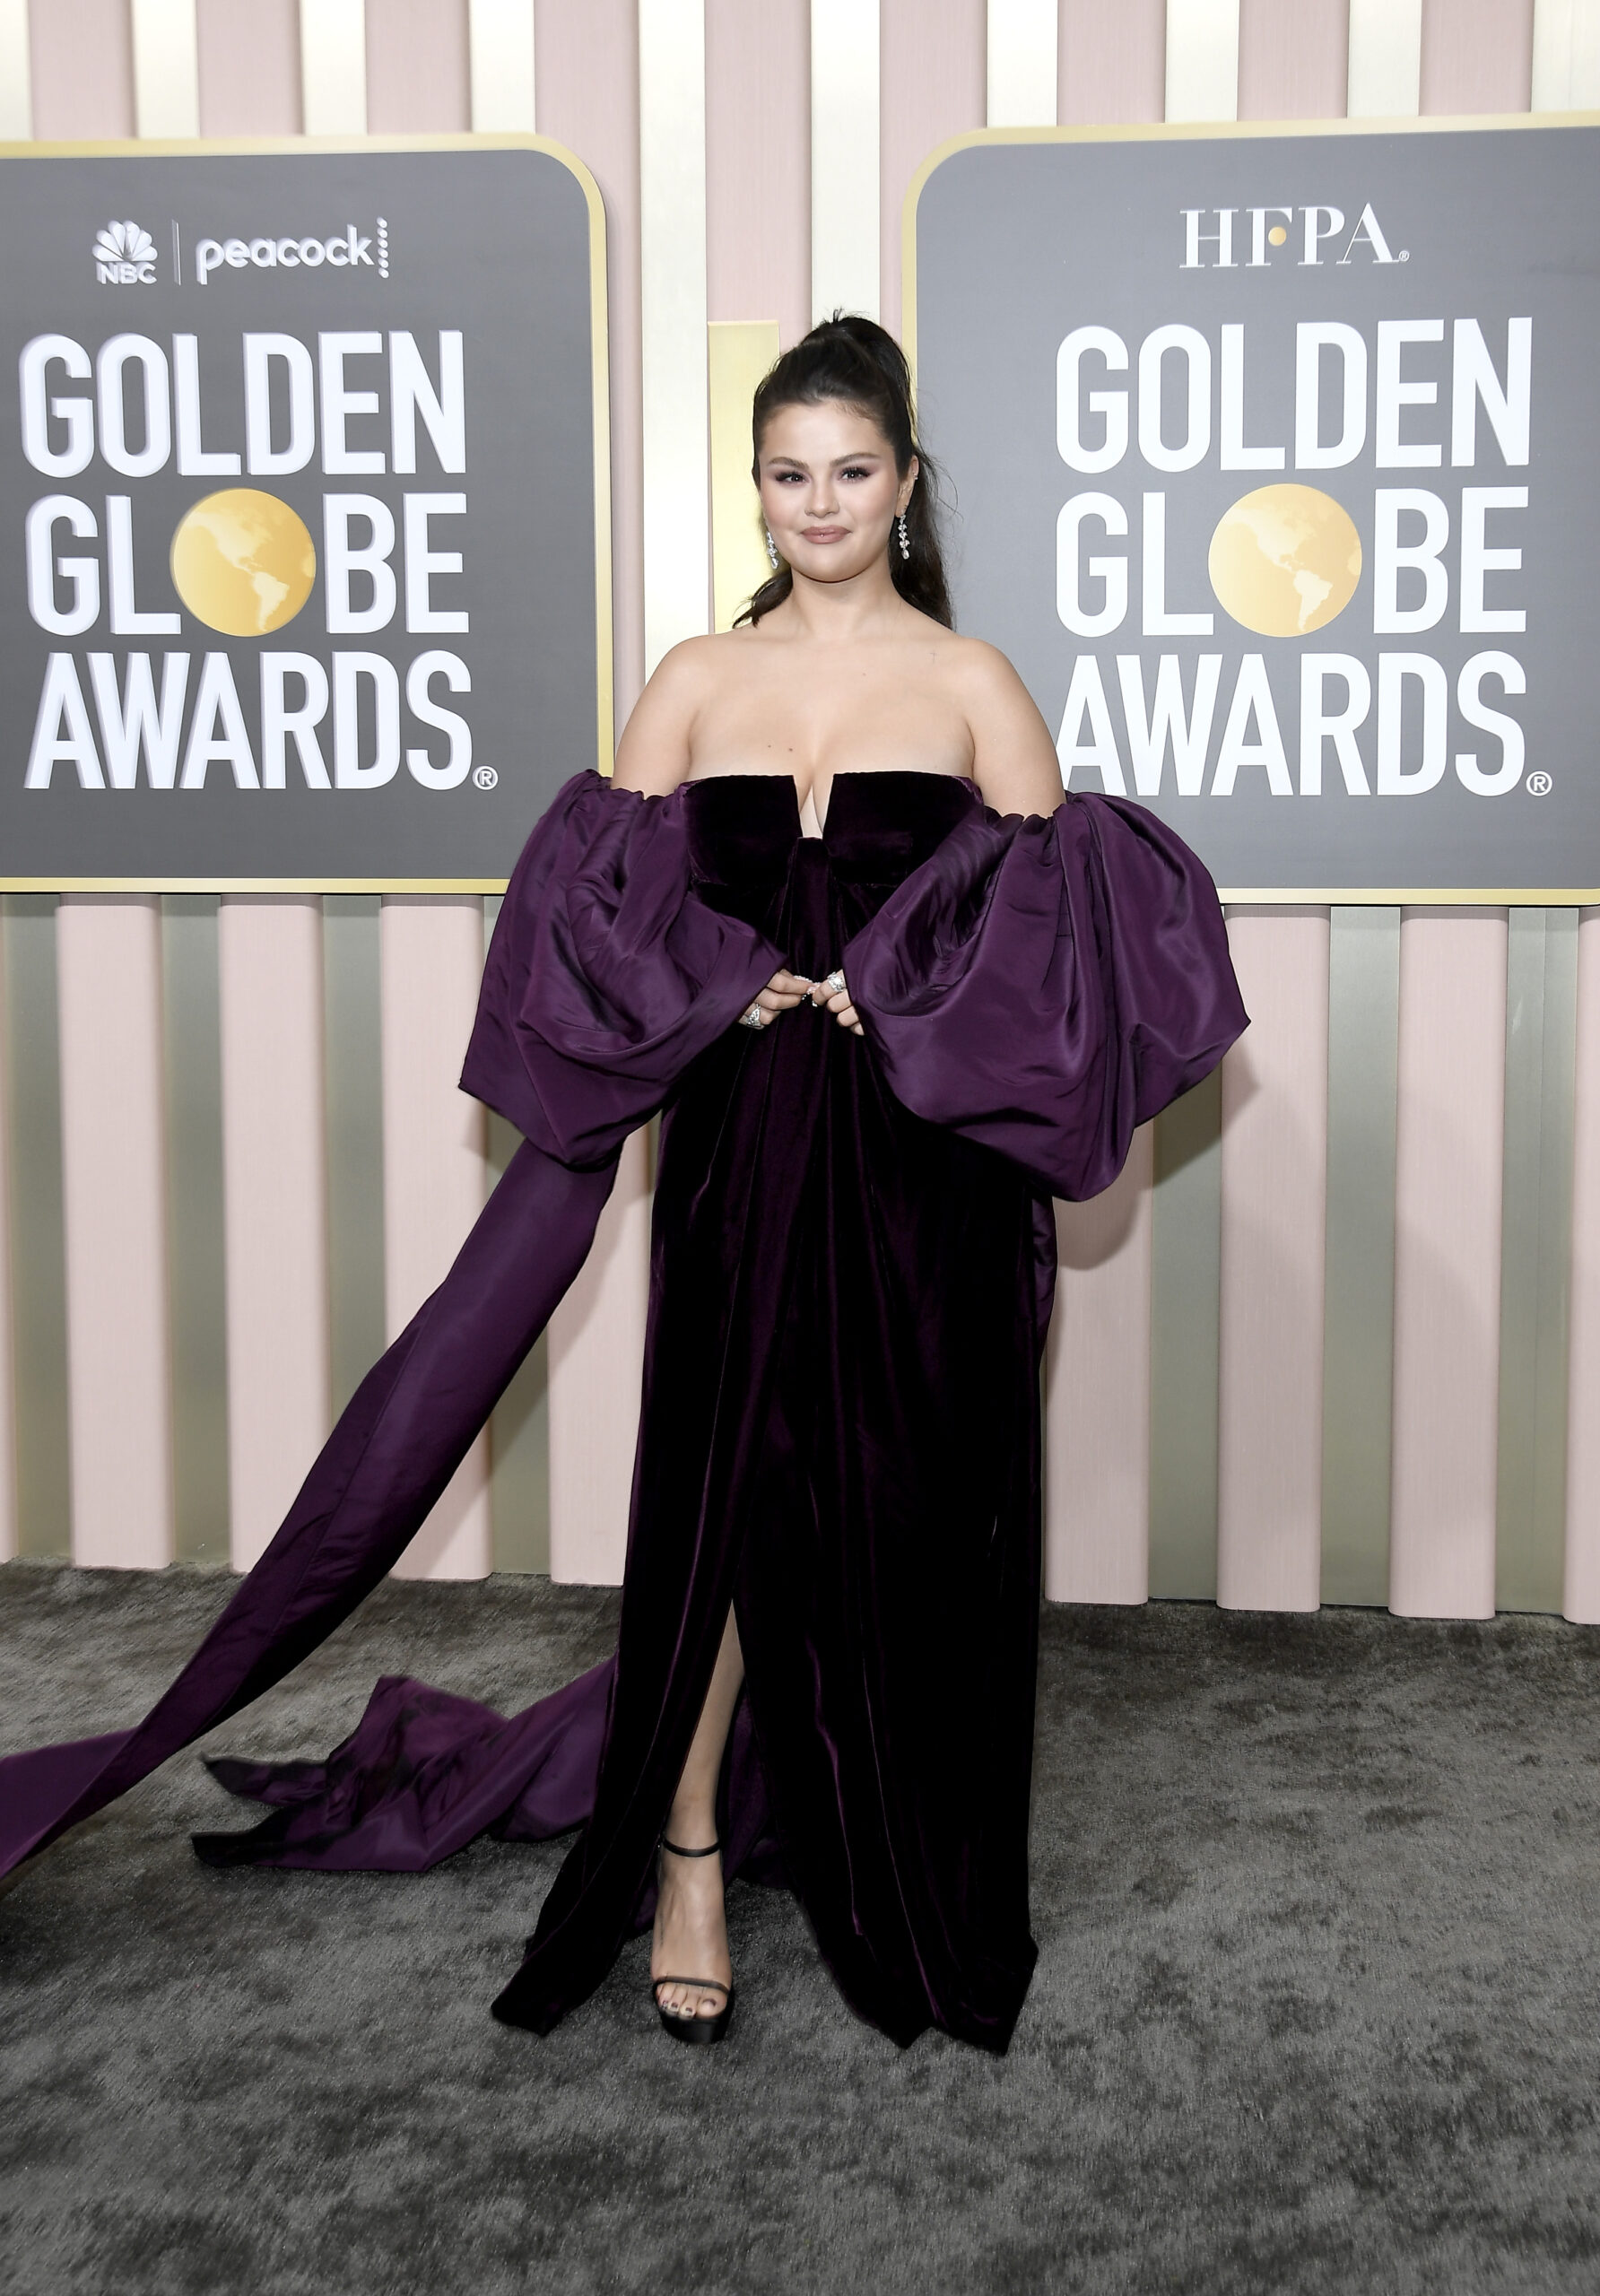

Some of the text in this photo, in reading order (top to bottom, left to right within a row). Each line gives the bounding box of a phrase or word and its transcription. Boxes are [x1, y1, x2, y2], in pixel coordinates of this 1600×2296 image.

[97, 224, 374, 284] NBC peacock
[18, 330, 467, 477] GOLDEN
[1056, 317, 1533, 474] GOLDEN
